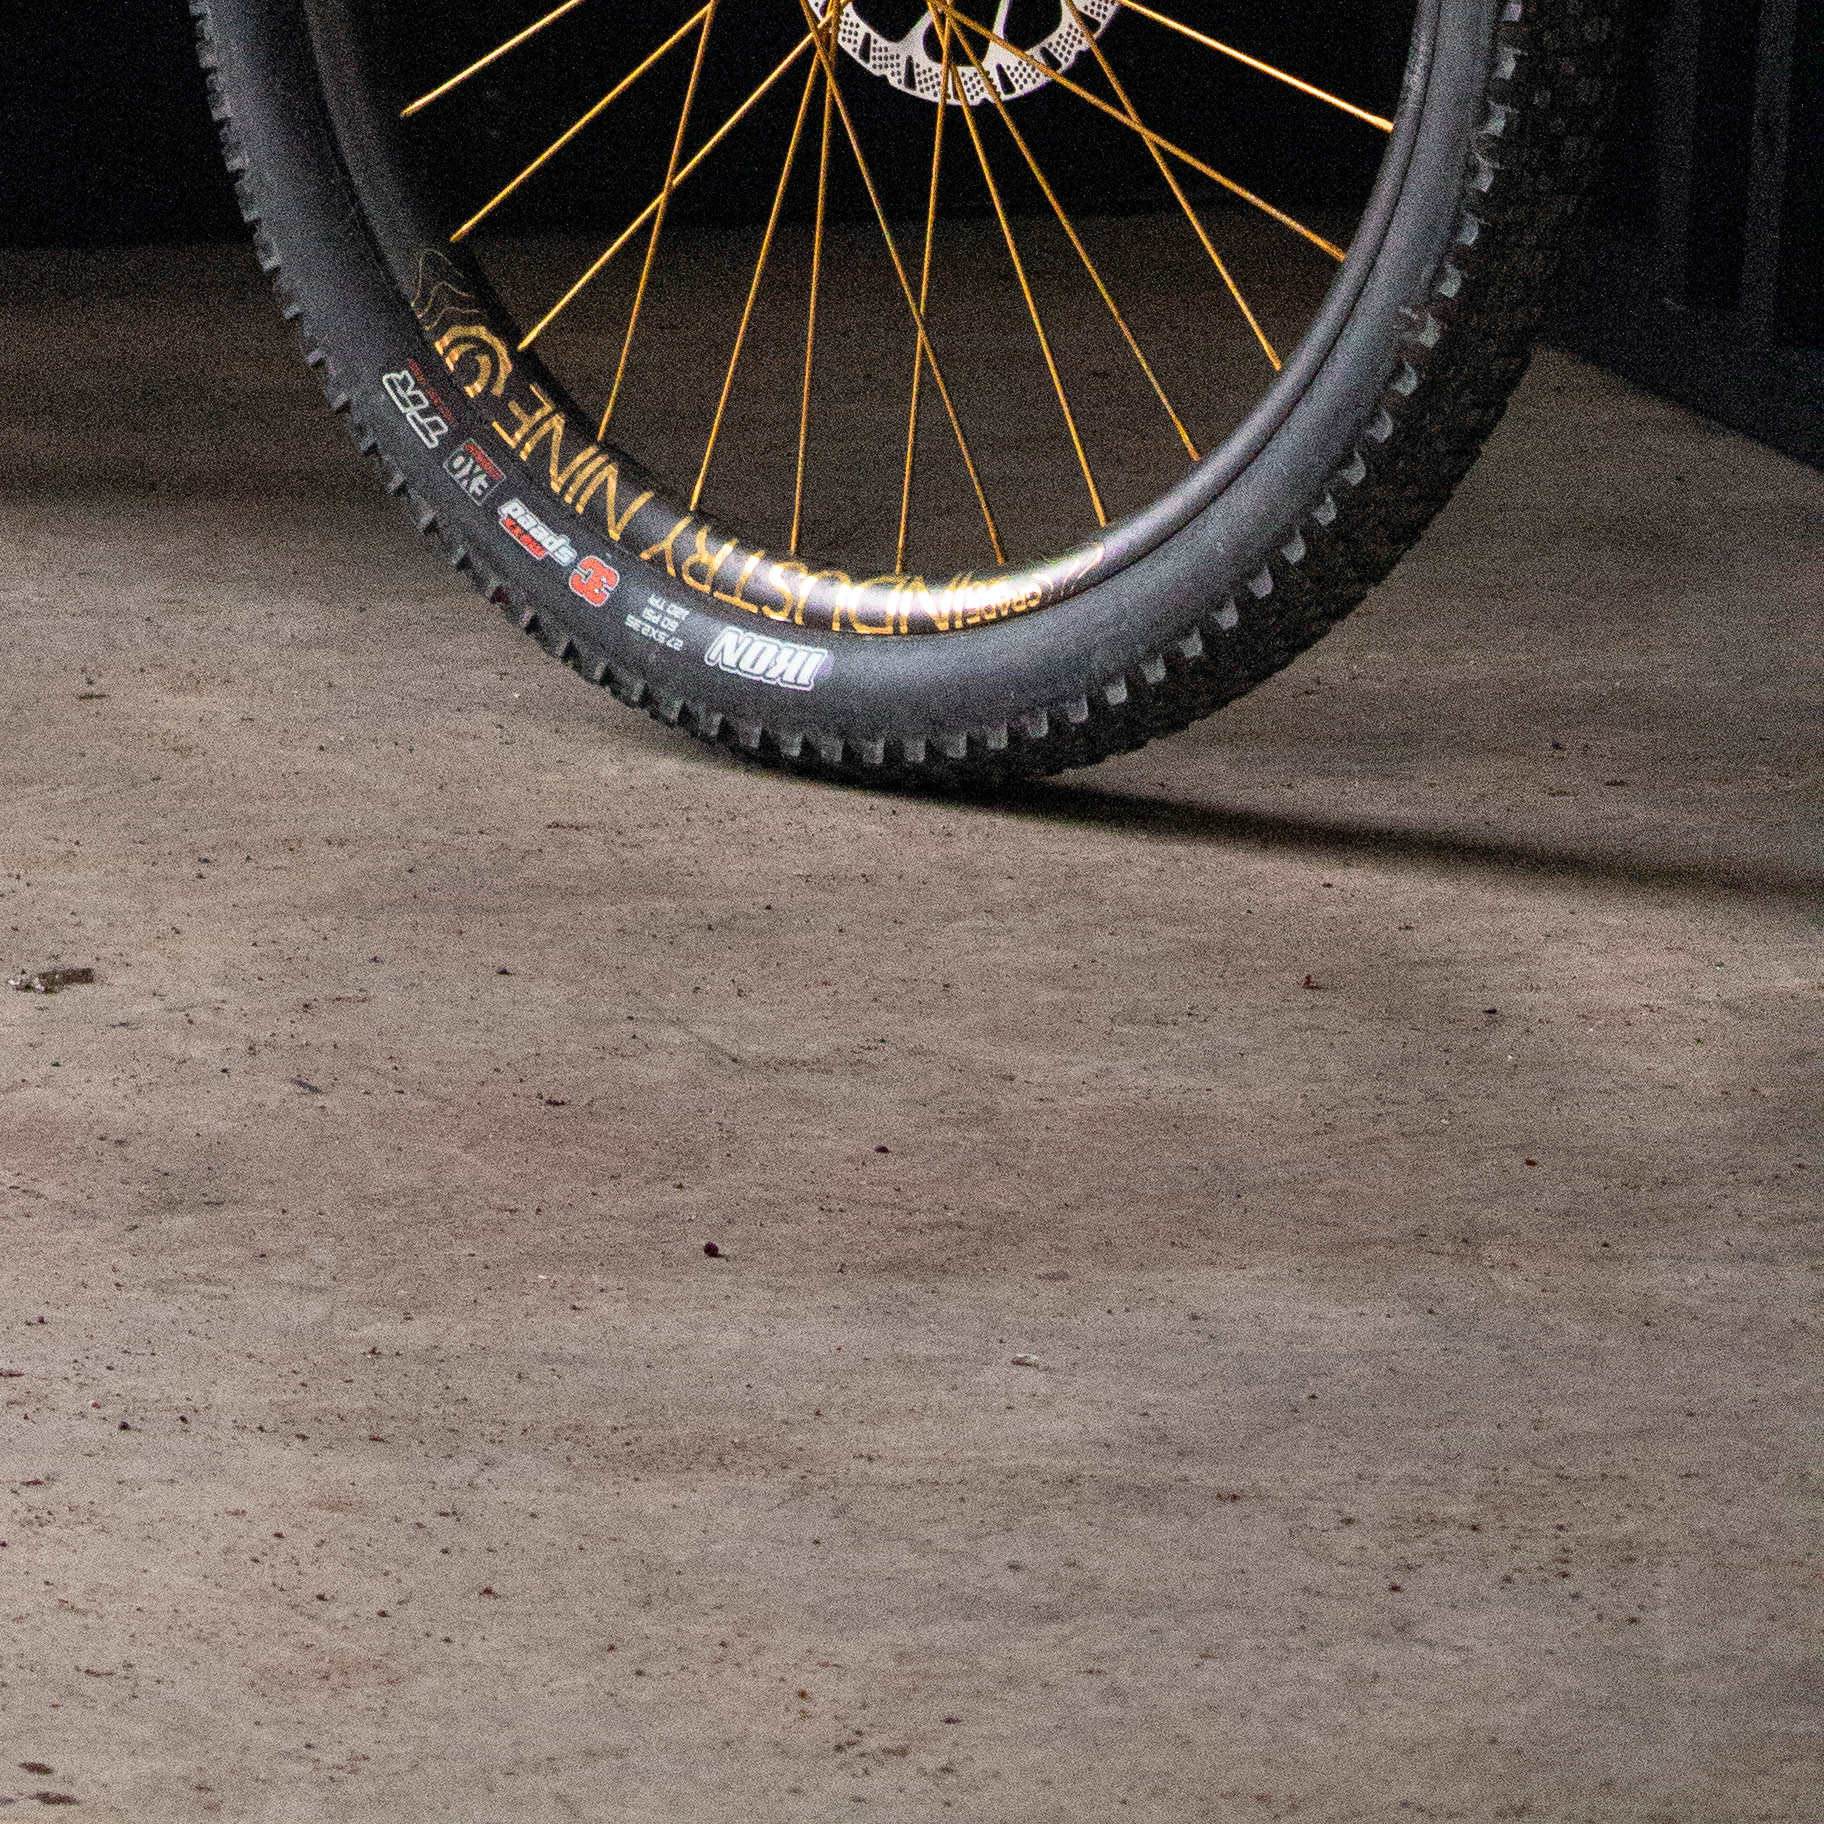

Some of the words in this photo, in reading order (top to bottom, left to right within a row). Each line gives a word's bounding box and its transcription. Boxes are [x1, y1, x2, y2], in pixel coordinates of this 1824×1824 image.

[382, 370, 449, 449] TR
[491, 383, 655, 541] NINE
[497, 498, 577, 566] speed
[569, 555, 620, 607] 3C
[640, 515, 974, 635] INDUSTRY
[705, 624, 832, 691] IKON
